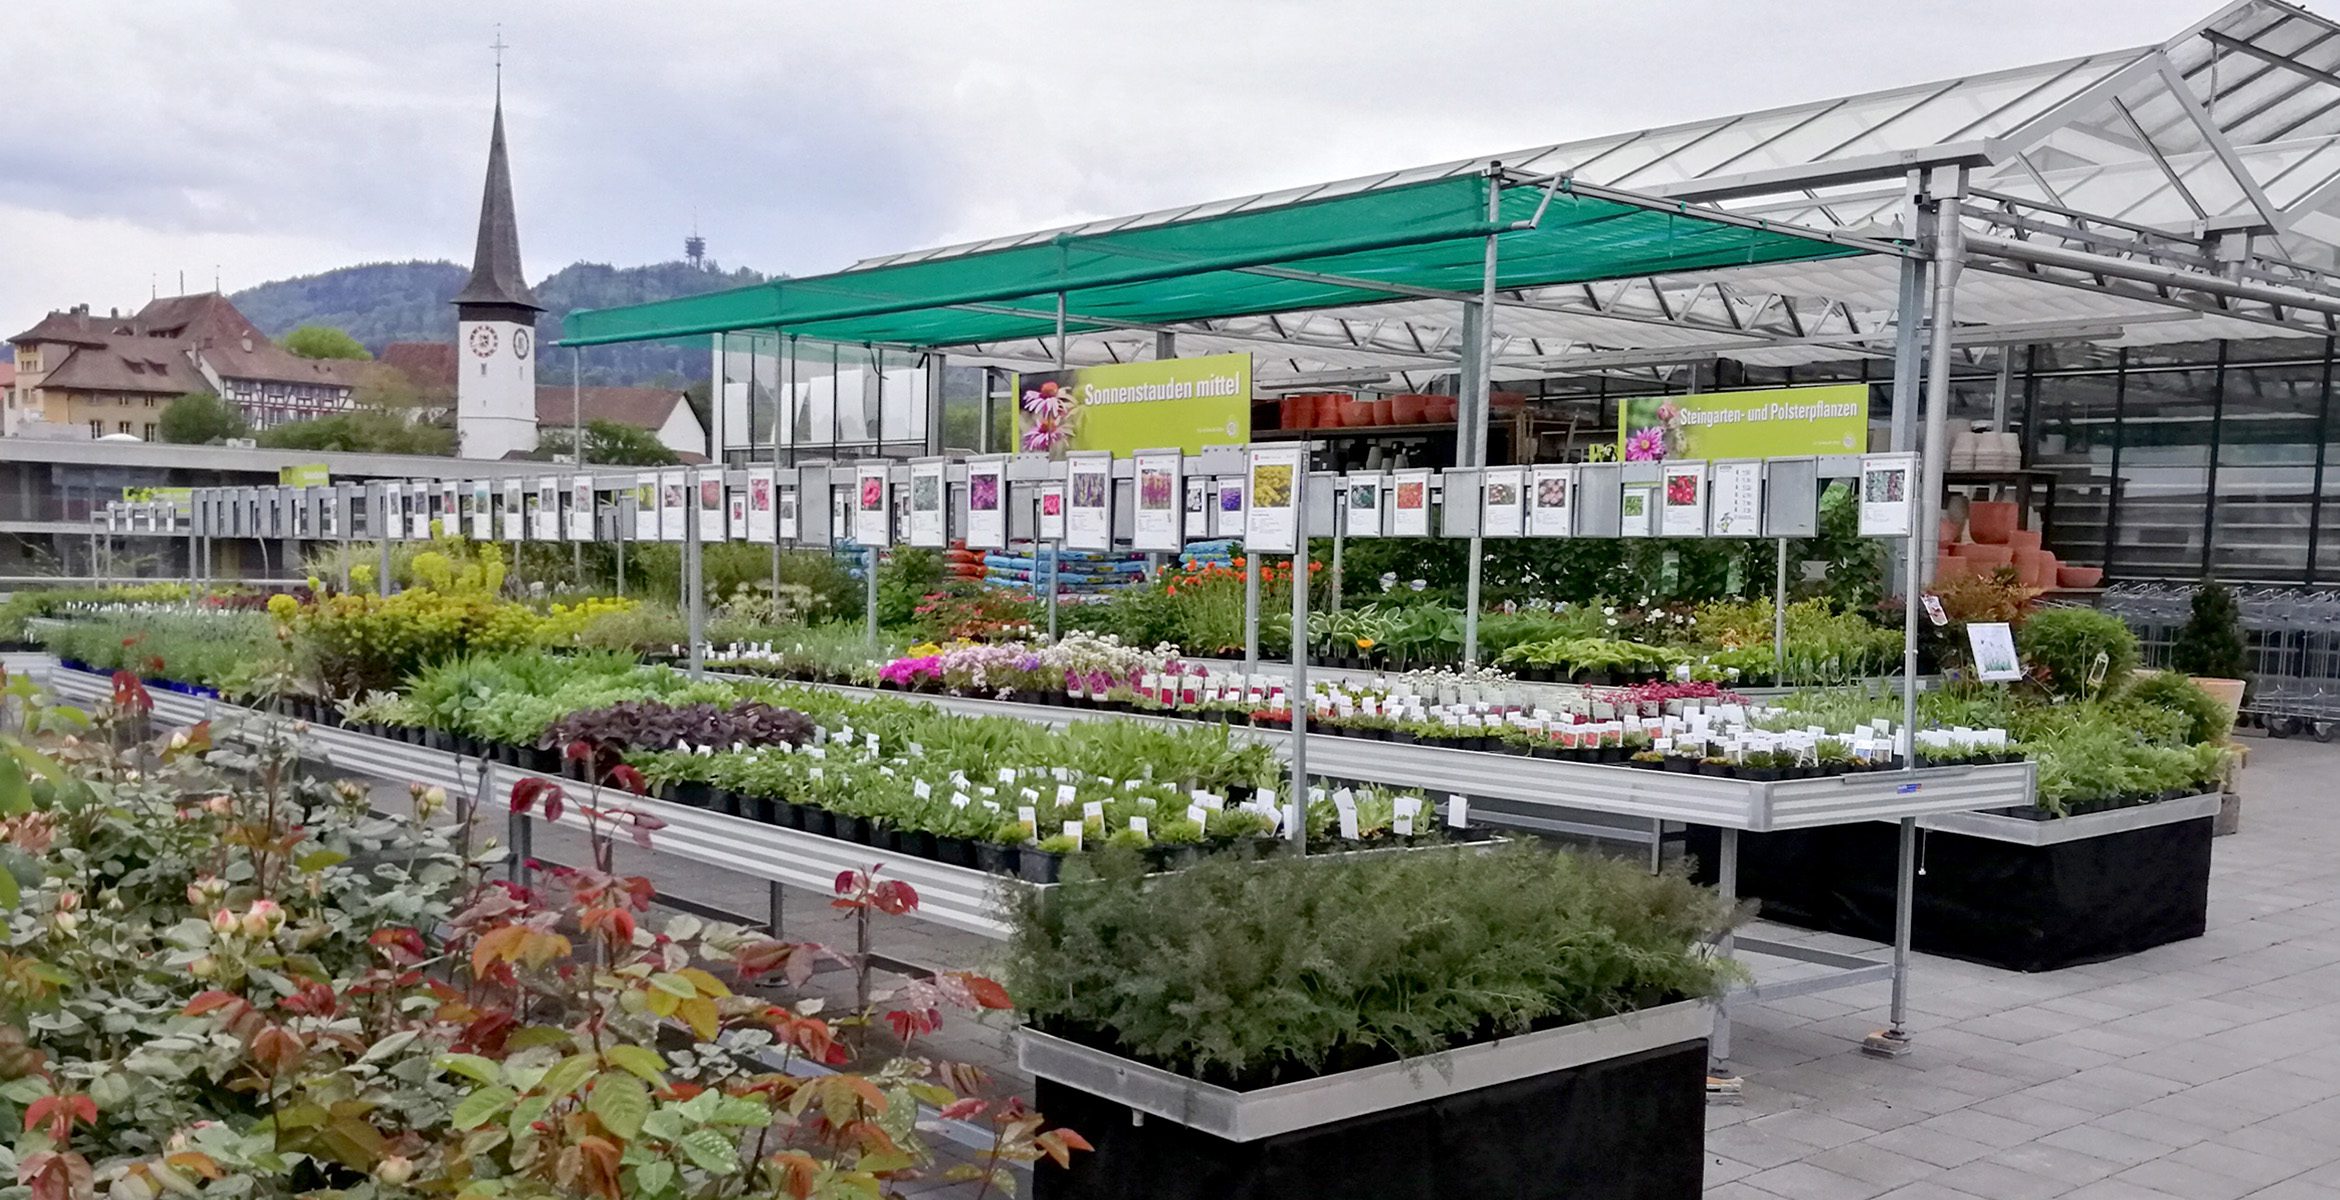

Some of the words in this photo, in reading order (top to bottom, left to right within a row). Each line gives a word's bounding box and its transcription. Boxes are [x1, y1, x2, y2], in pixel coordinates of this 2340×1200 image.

[1085, 378, 1192, 405] Sonnenstauden
[1196, 371, 1240, 398] mittel
[1680, 407, 1745, 428] Steingarten-
[1748, 405, 1768, 422] und
[1771, 402, 1858, 421] Polsterpflanzen
